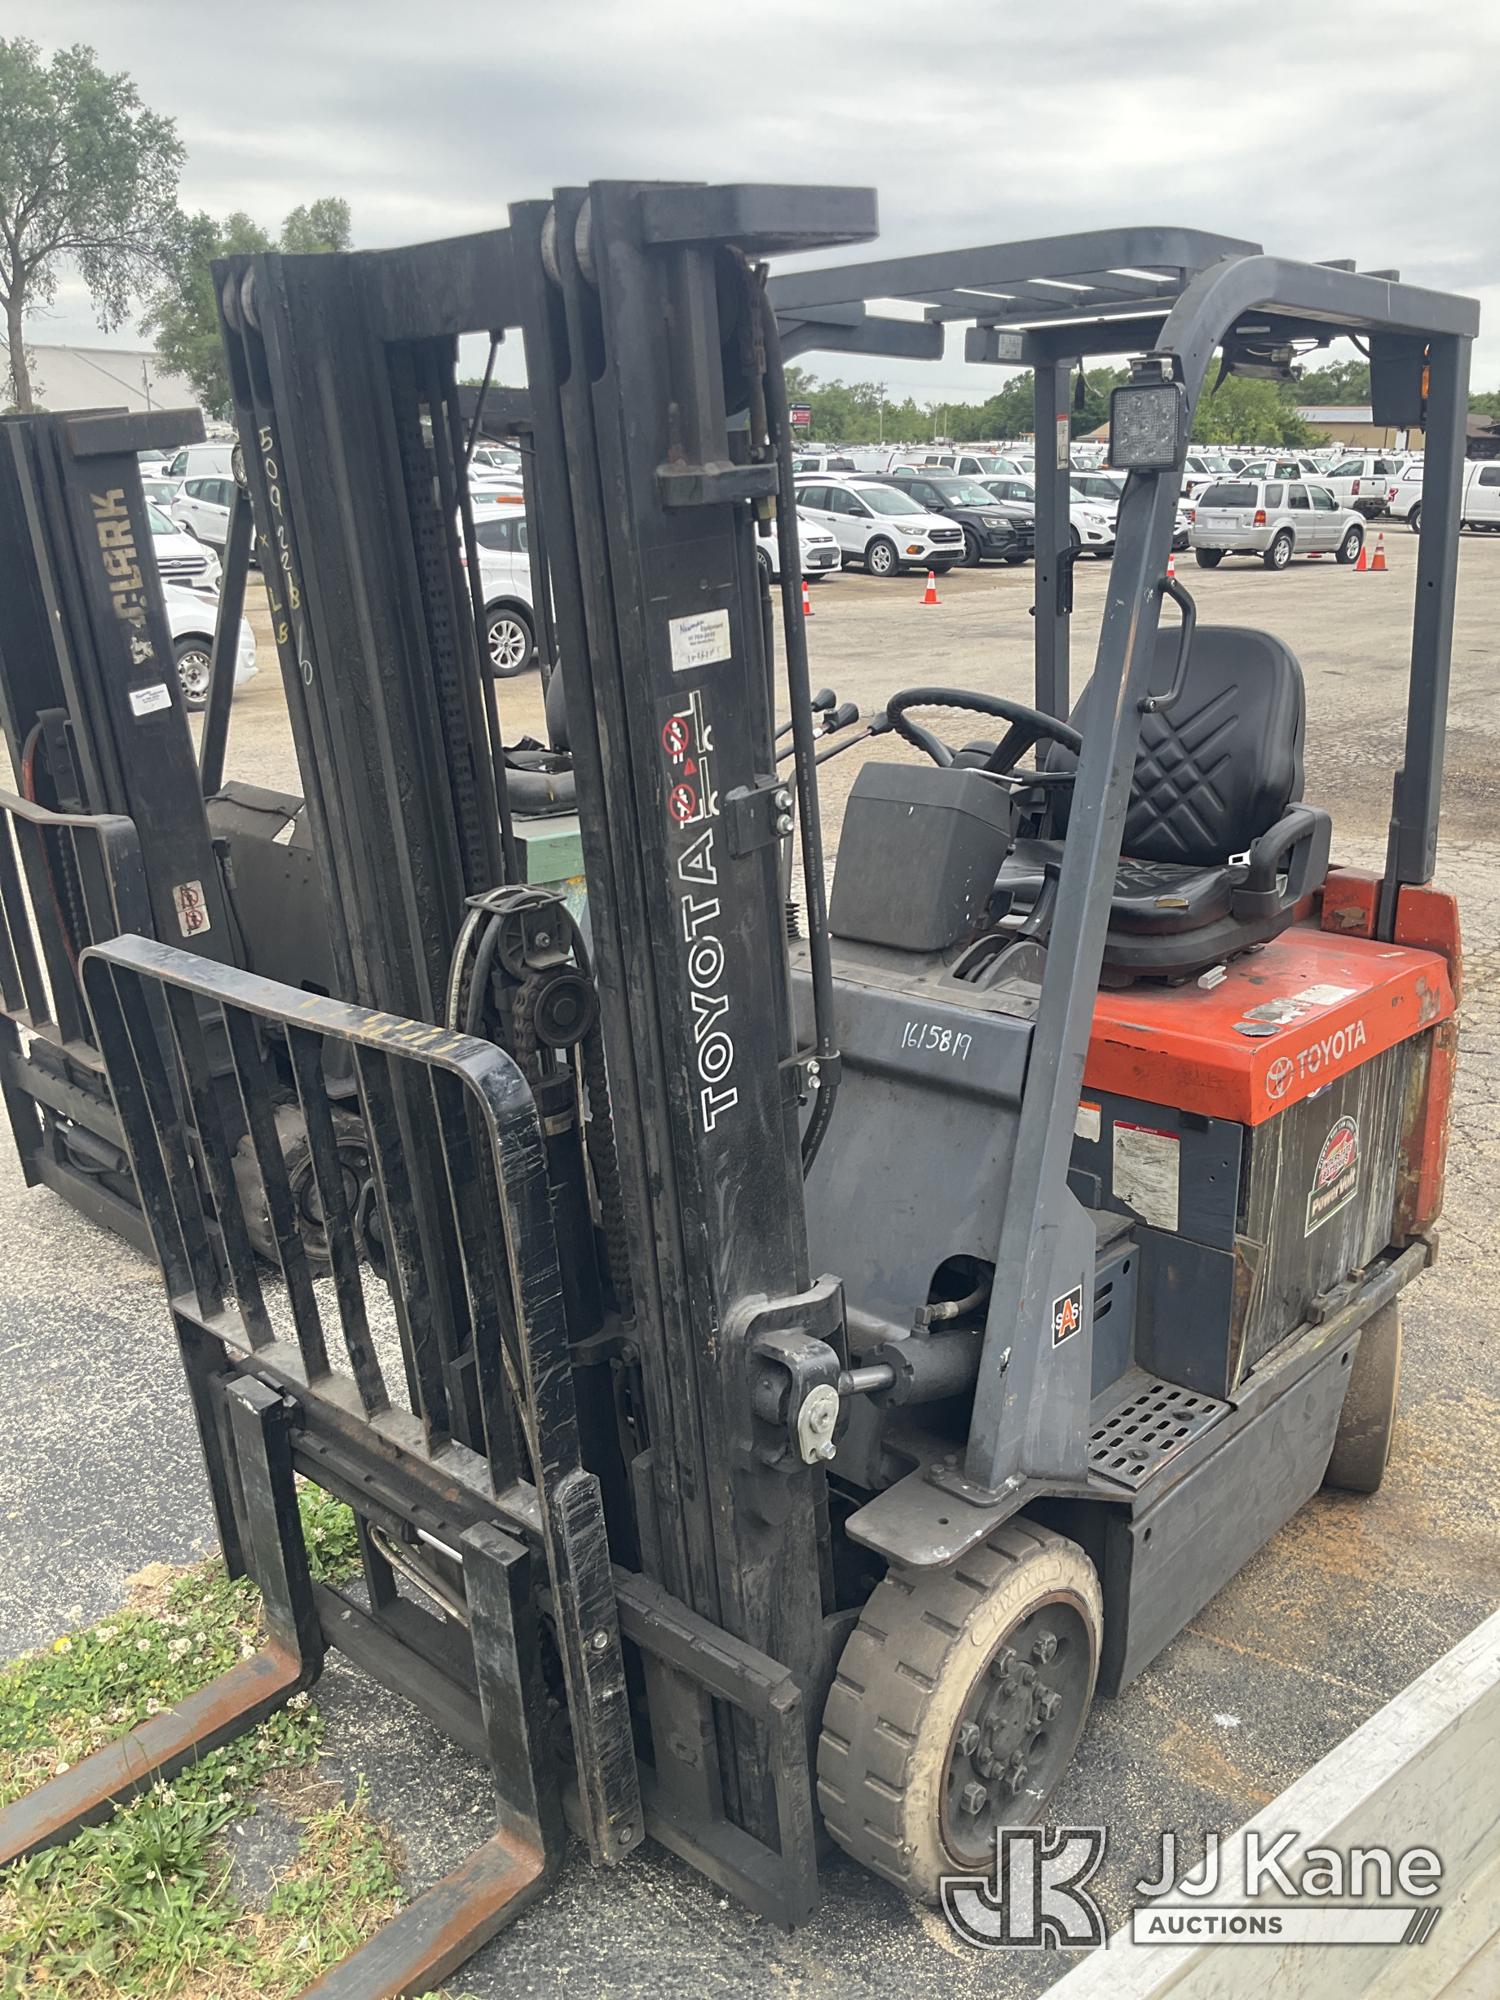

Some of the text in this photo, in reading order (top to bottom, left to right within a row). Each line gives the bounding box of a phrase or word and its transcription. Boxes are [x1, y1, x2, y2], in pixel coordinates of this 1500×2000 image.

[677, 828, 738, 1133] TOYOTA
[901, 1022, 972, 1061] 1615819
[1297, 1020, 1366, 1080] TOYOTA
